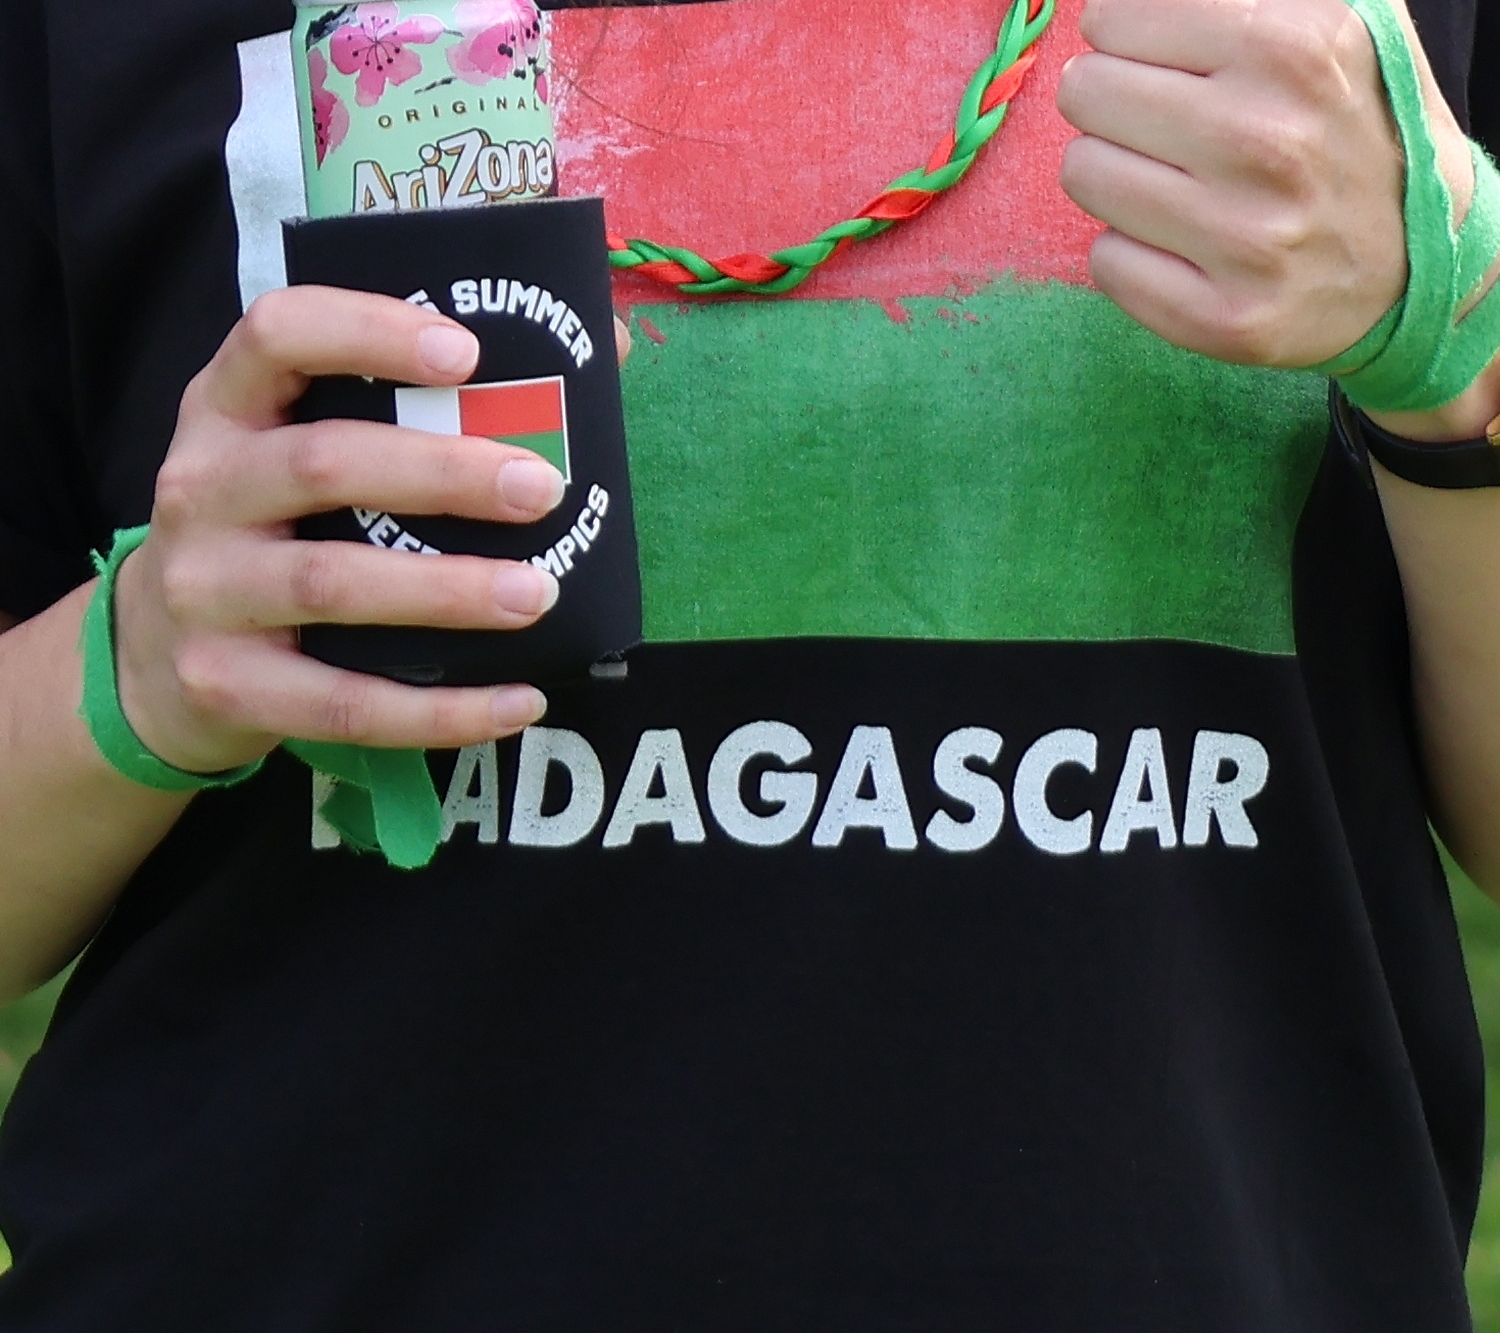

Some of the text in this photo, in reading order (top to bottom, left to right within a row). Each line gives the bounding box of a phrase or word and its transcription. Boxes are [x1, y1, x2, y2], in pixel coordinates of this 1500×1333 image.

[377, 96, 540, 129] ORIGINAL
[352, 127, 553, 213] AriZona
[450, 278, 594, 369] SUMMER
[521, 482, 609, 578] MPICS
